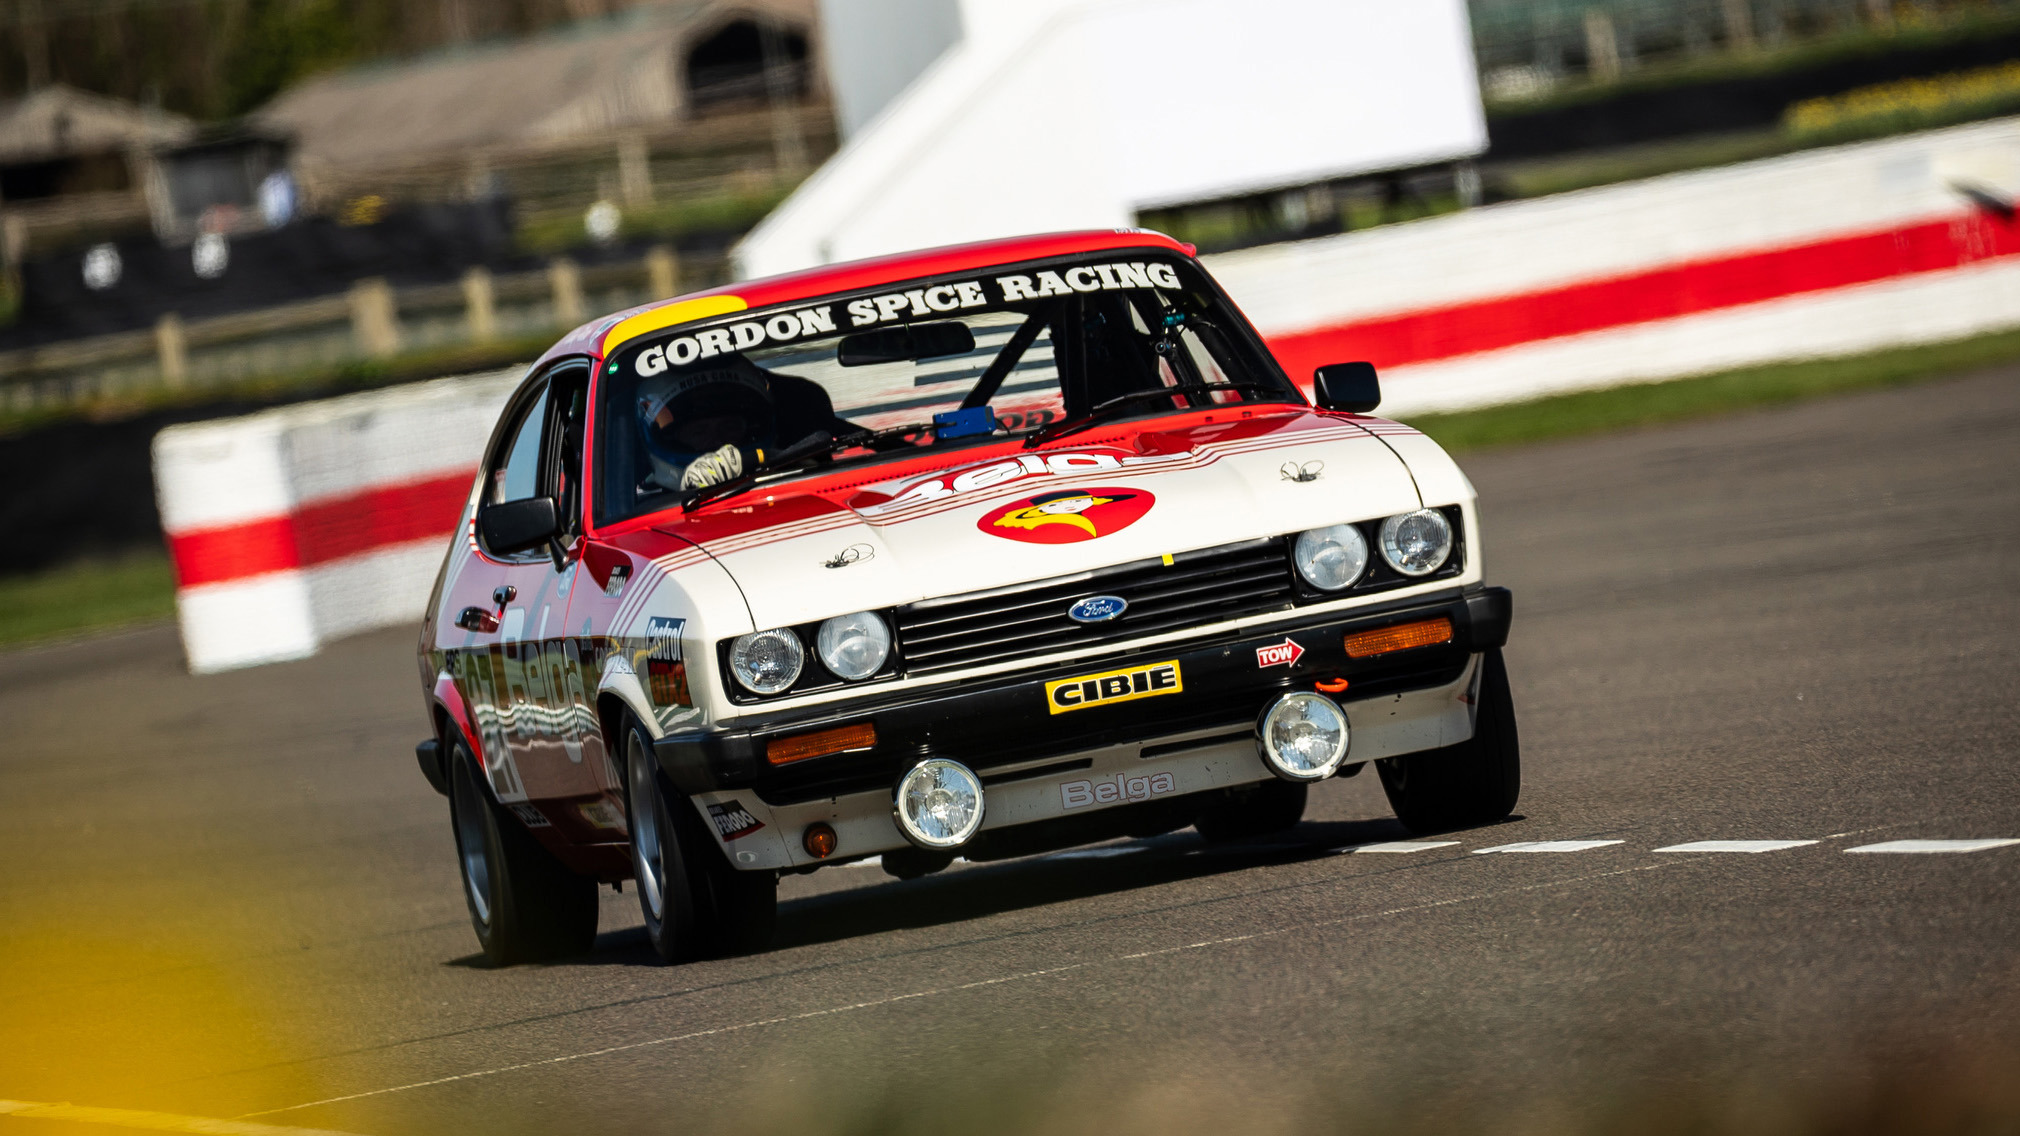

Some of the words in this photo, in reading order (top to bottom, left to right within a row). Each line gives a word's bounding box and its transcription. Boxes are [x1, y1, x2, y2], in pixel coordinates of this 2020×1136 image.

[635, 306, 836, 378] GORDON
[847, 281, 988, 327] SPICE
[996, 262, 1182, 302] RACING
[1083, 600, 1113, 617] Ford
[646, 618, 685, 662] Castrol
[1259, 645, 1293, 664] TOW
[1060, 771, 1176, 810] Belga
